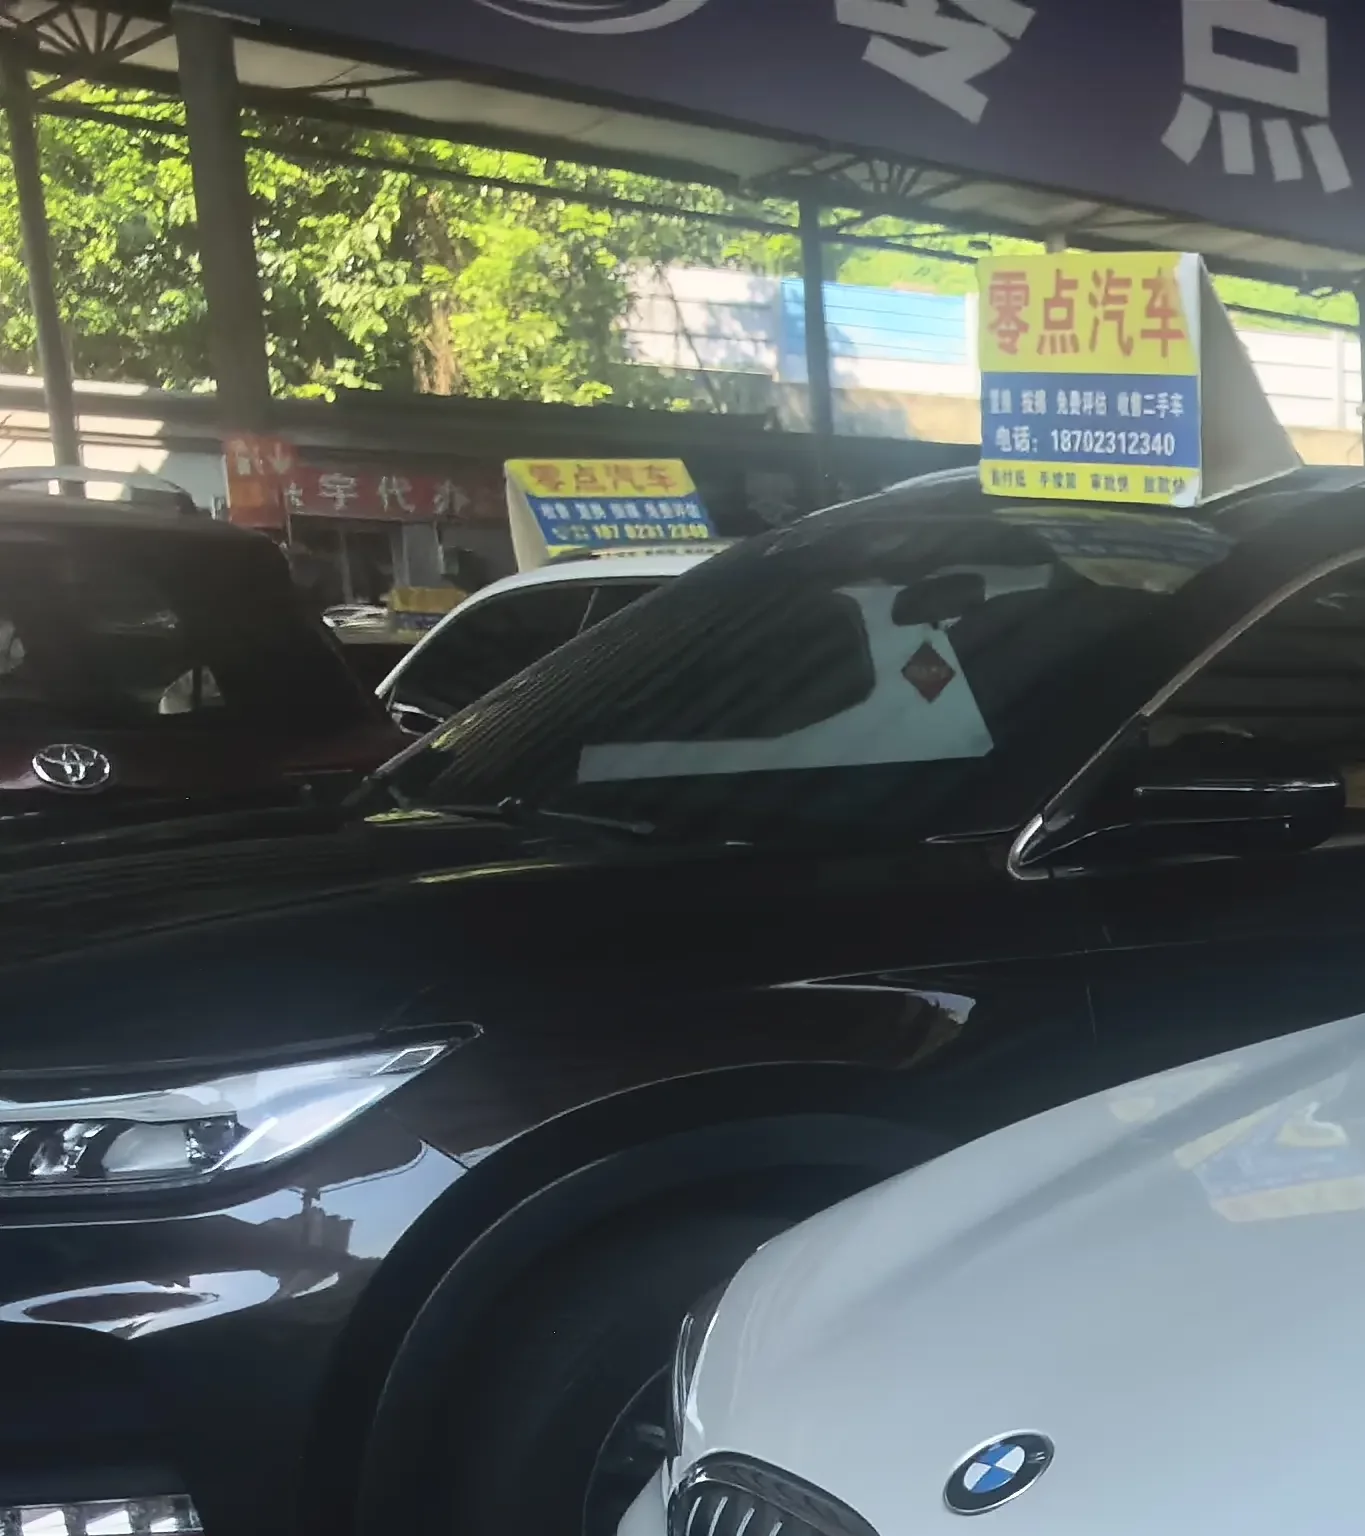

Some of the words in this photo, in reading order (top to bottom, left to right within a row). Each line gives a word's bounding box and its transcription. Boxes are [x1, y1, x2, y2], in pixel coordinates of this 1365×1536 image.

[988, 267, 1186, 358] 零点汽车
[1050, 428, 1176, 457] 18702312340
